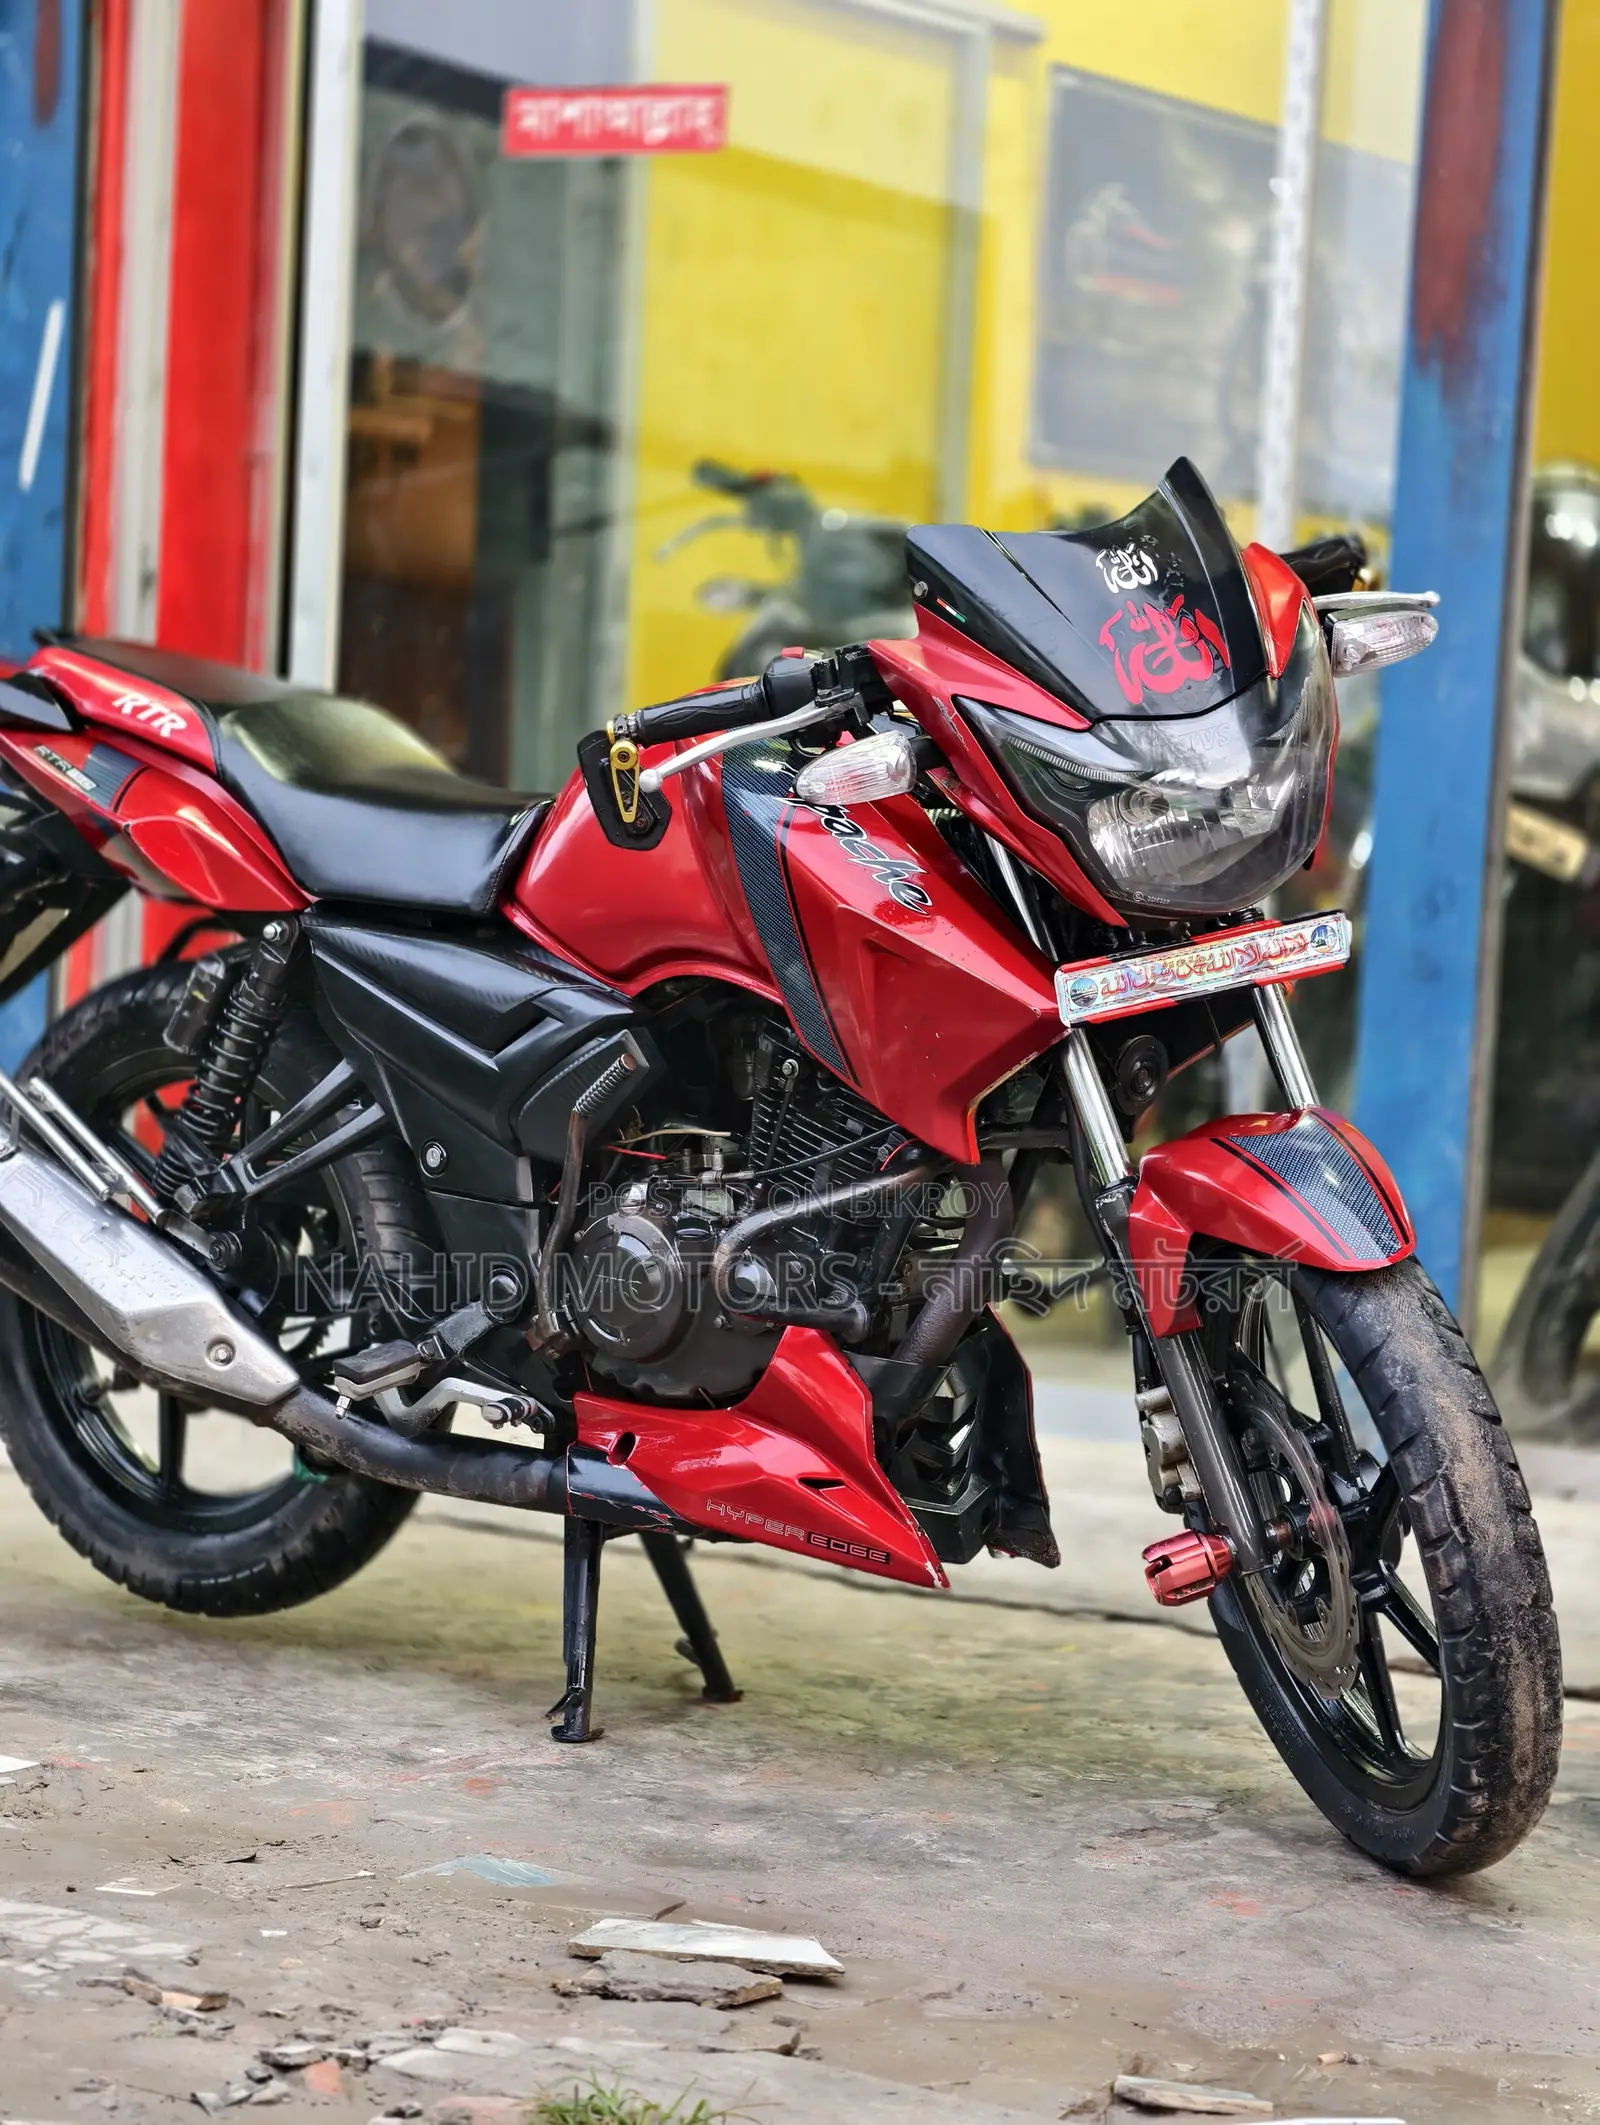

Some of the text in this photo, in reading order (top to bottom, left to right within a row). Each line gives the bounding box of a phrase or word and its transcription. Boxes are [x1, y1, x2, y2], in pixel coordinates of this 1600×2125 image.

[112, 691, 187, 737] RTR
[777, 796, 933, 915] ache
[706, 1499, 888, 1563] HYPER EDGE
